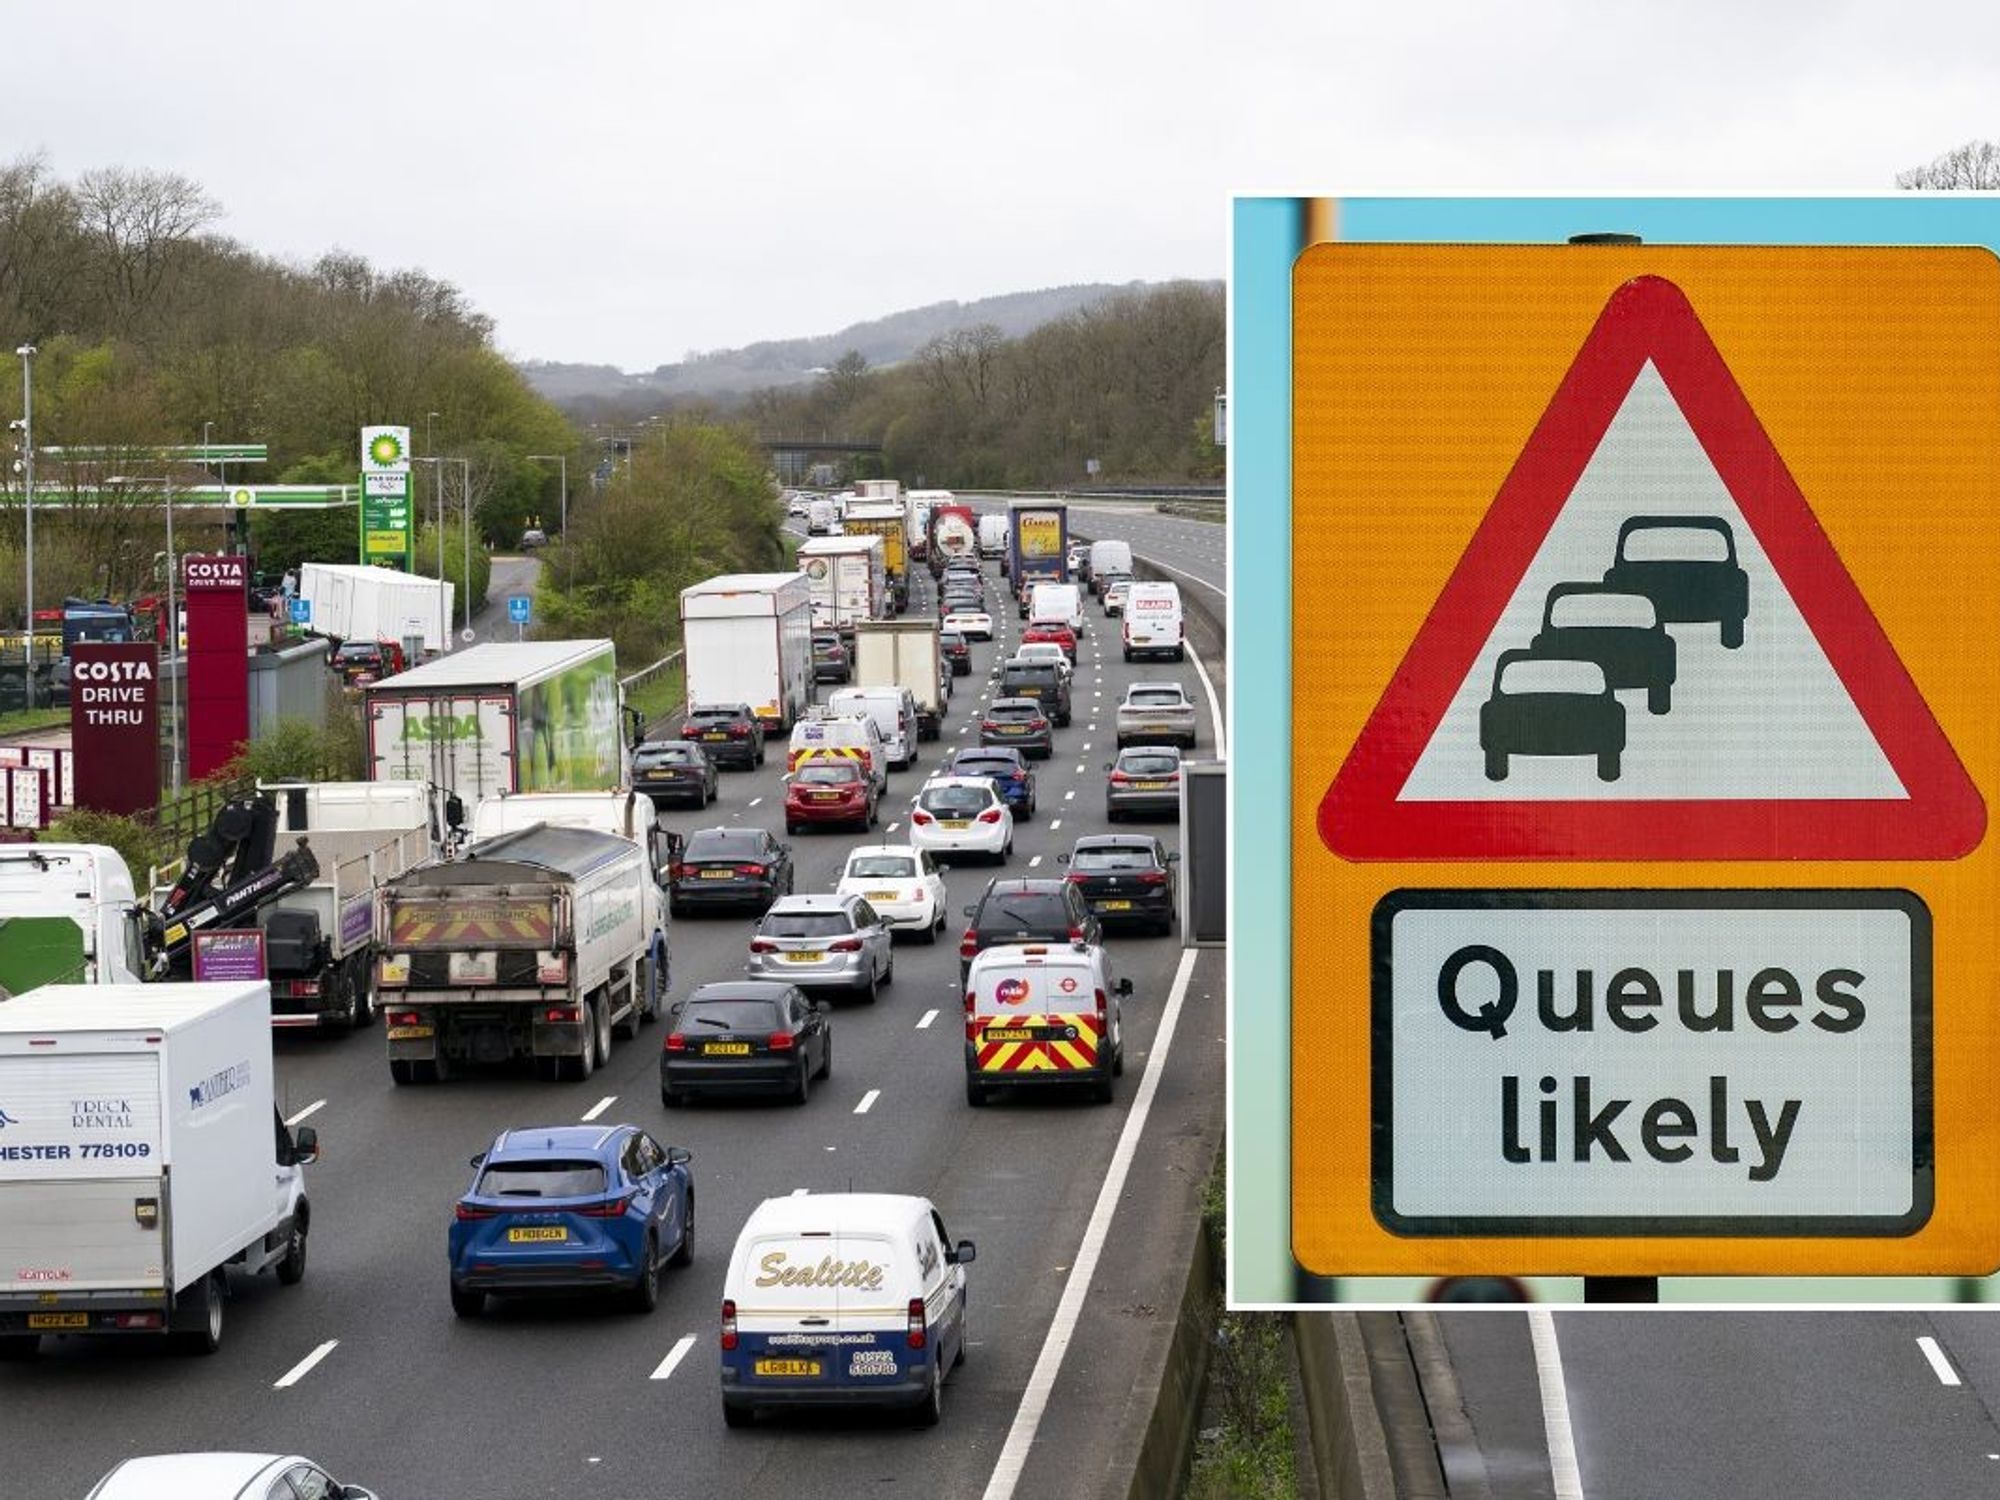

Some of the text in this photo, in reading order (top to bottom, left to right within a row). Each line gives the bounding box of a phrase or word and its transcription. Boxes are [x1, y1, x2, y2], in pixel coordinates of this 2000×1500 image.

[188, 564, 242, 578] COSTA
[74, 662, 153, 682] COSTA
[82, 688, 145, 702] DRIVE
[86, 710, 143, 725] THRU
[400, 714, 485, 740] ASDA
[461, 911, 535, 921] MAINTENANCE
[1437, 944, 1867, 1040] Queues
[72, 1100, 131, 1113] TRUCK
[72, 1115, 132, 1128] RENTAL
[1501, 1075, 1803, 1182] likely
[79, 1143, 150, 1158] 778109
[756, 1252, 885, 1287] Sealtite
